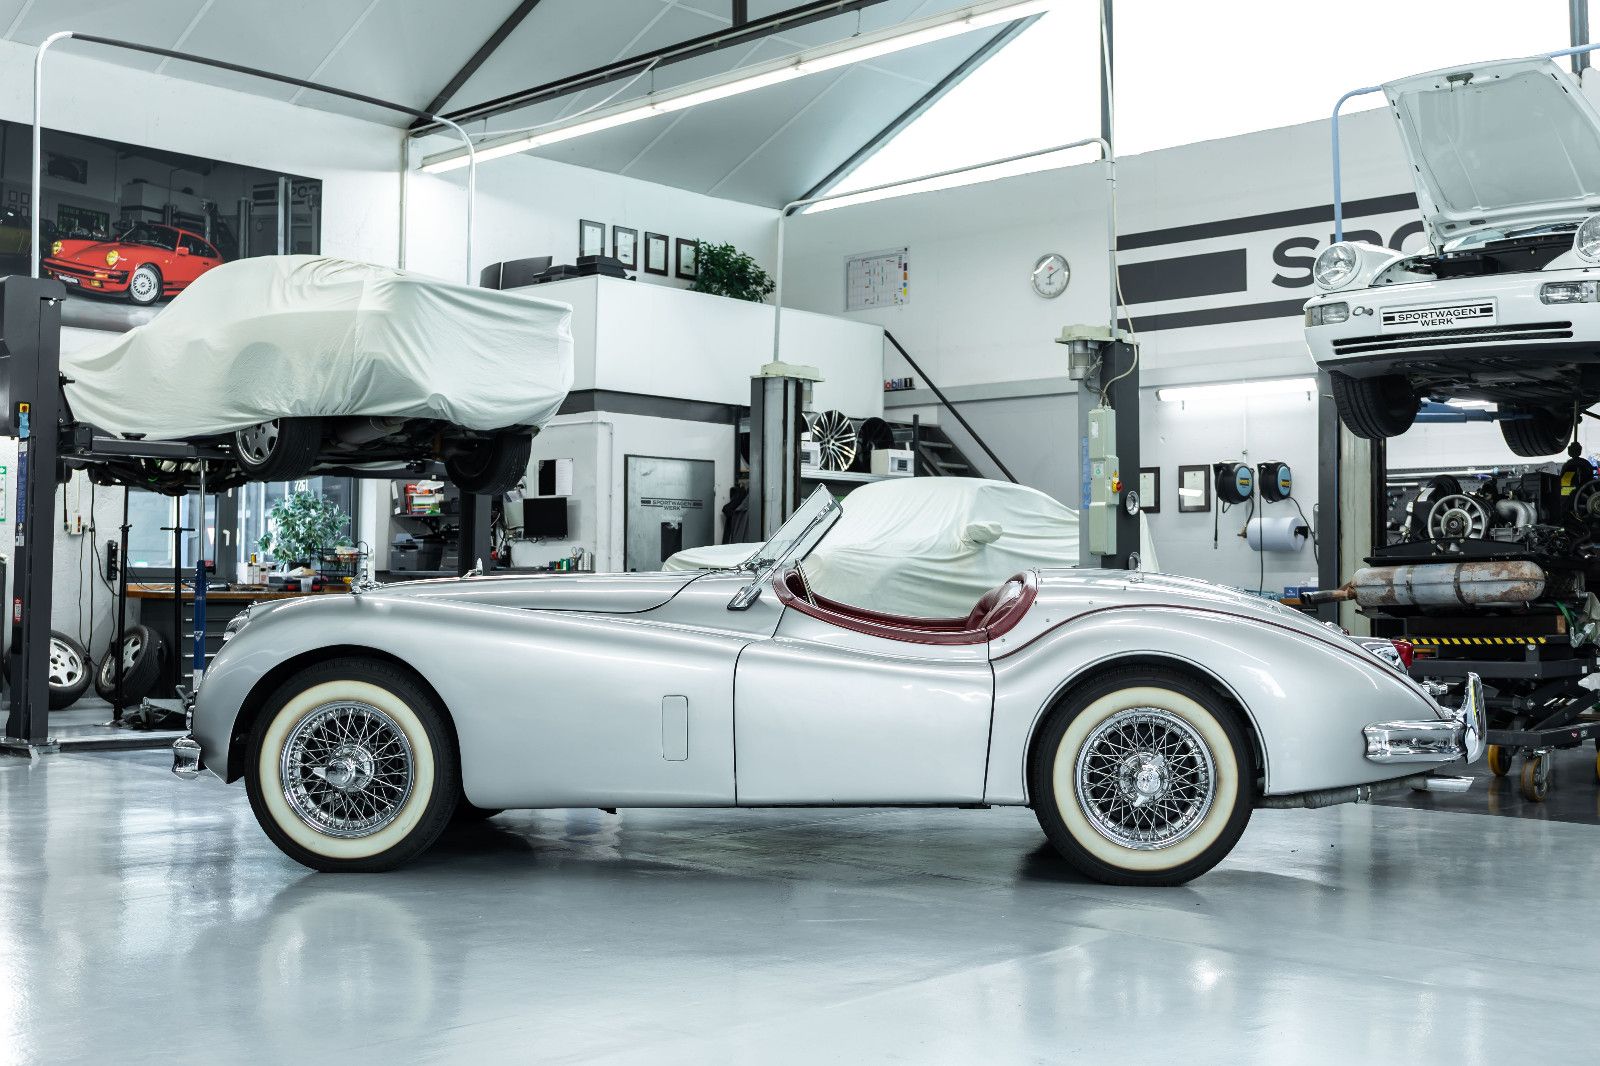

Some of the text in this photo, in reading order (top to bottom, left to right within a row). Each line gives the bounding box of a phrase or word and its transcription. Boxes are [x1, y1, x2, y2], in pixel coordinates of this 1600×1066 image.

[1397, 307, 1478, 321] SPORTWAGEN
[1420, 317, 1454, 327] WERK
[884, 378, 903, 389] obil
[652, 499, 693, 507] SPORTWAGEN
